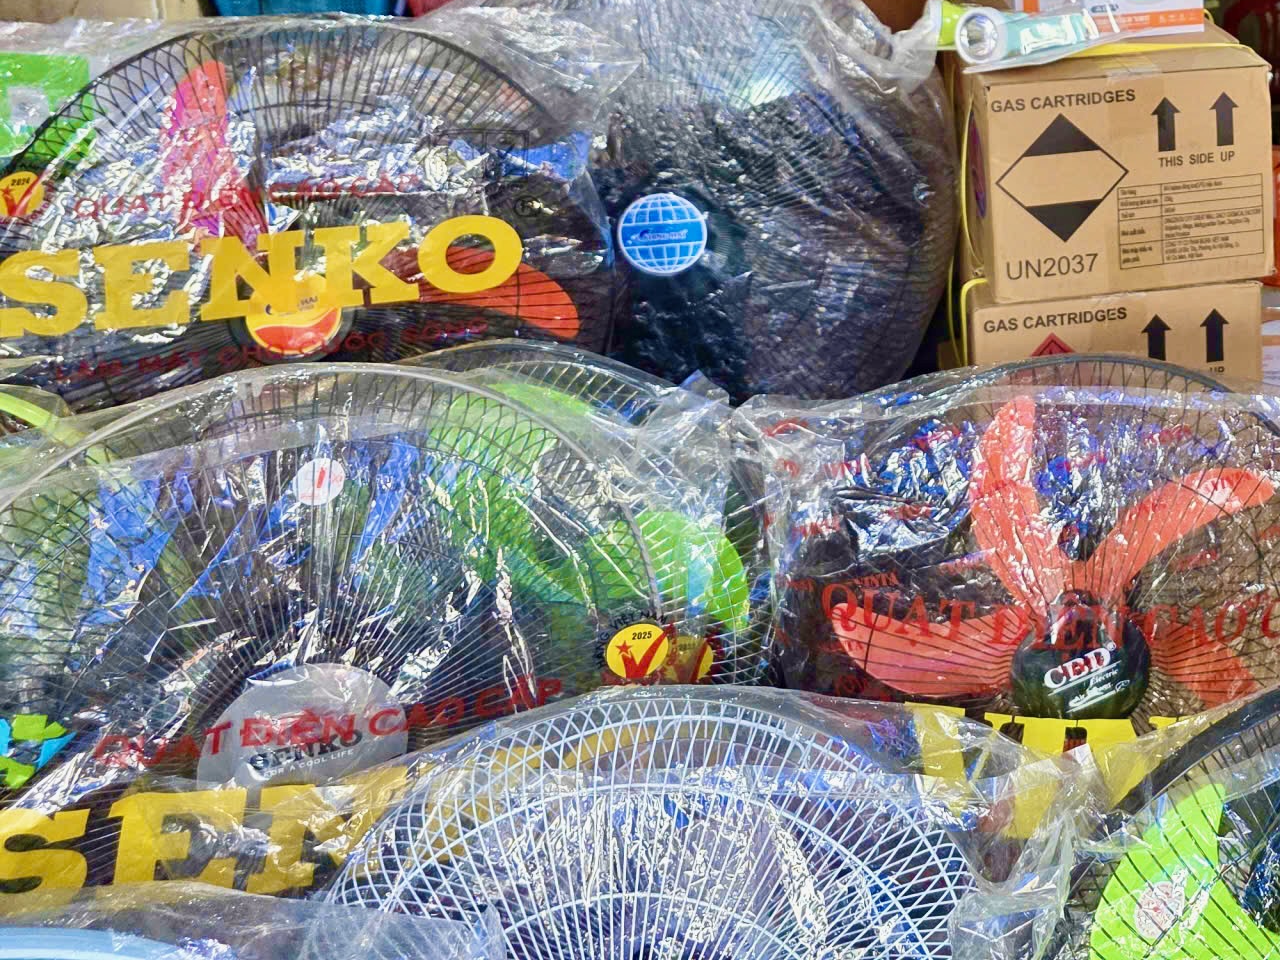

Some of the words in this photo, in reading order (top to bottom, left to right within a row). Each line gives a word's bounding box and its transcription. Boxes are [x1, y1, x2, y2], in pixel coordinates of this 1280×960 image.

[991, 98, 1025, 113] GAS
[1030, 89, 1136, 110] CARTRIDGES
[1158, 155, 1183, 168] THIS
[1189, 153, 1214, 166] SIDE
[1220, 151, 1235, 162] UP
[0, 214, 523, 339] SENKO
[1006, 253, 1099, 280] UN2037
[984, 318, 1019, 333] GAS
[1023, 307, 1127, 329] CARTRIDGES
[632, 631, 652, 641] 2025
[1044, 647, 1111, 689] CBD
[369, 696, 465, 735] CAO
[301, 756, 330, 770] COOL
[332, 748, 354, 762] LIFE
